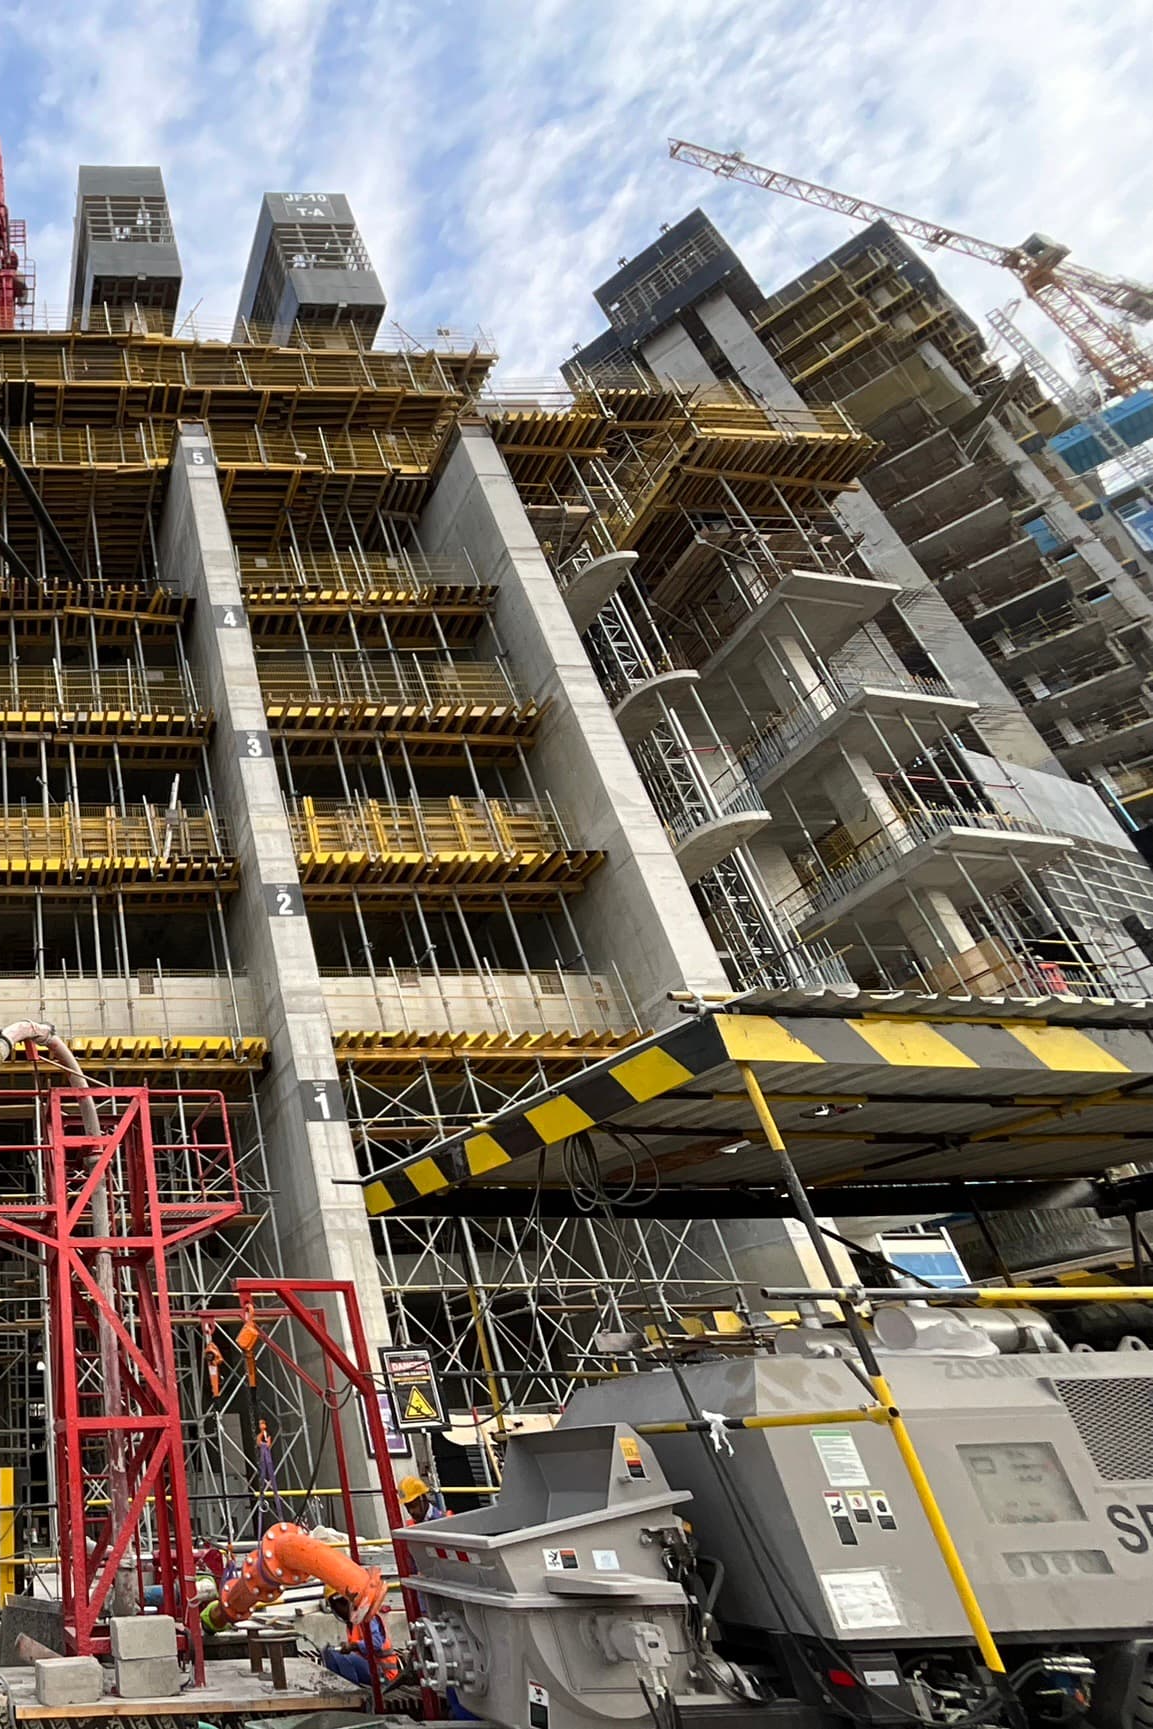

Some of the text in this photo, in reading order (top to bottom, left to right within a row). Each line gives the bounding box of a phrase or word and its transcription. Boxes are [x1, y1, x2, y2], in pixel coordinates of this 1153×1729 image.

[296, 207, 324, 216] T-A
[193, 452, 204, 465] 5
[224, 611, 237, 627] 4
[247, 737, 262, 757] 3
[277, 893, 293, 915] 2
[314, 1092, 330, 1119] 1
